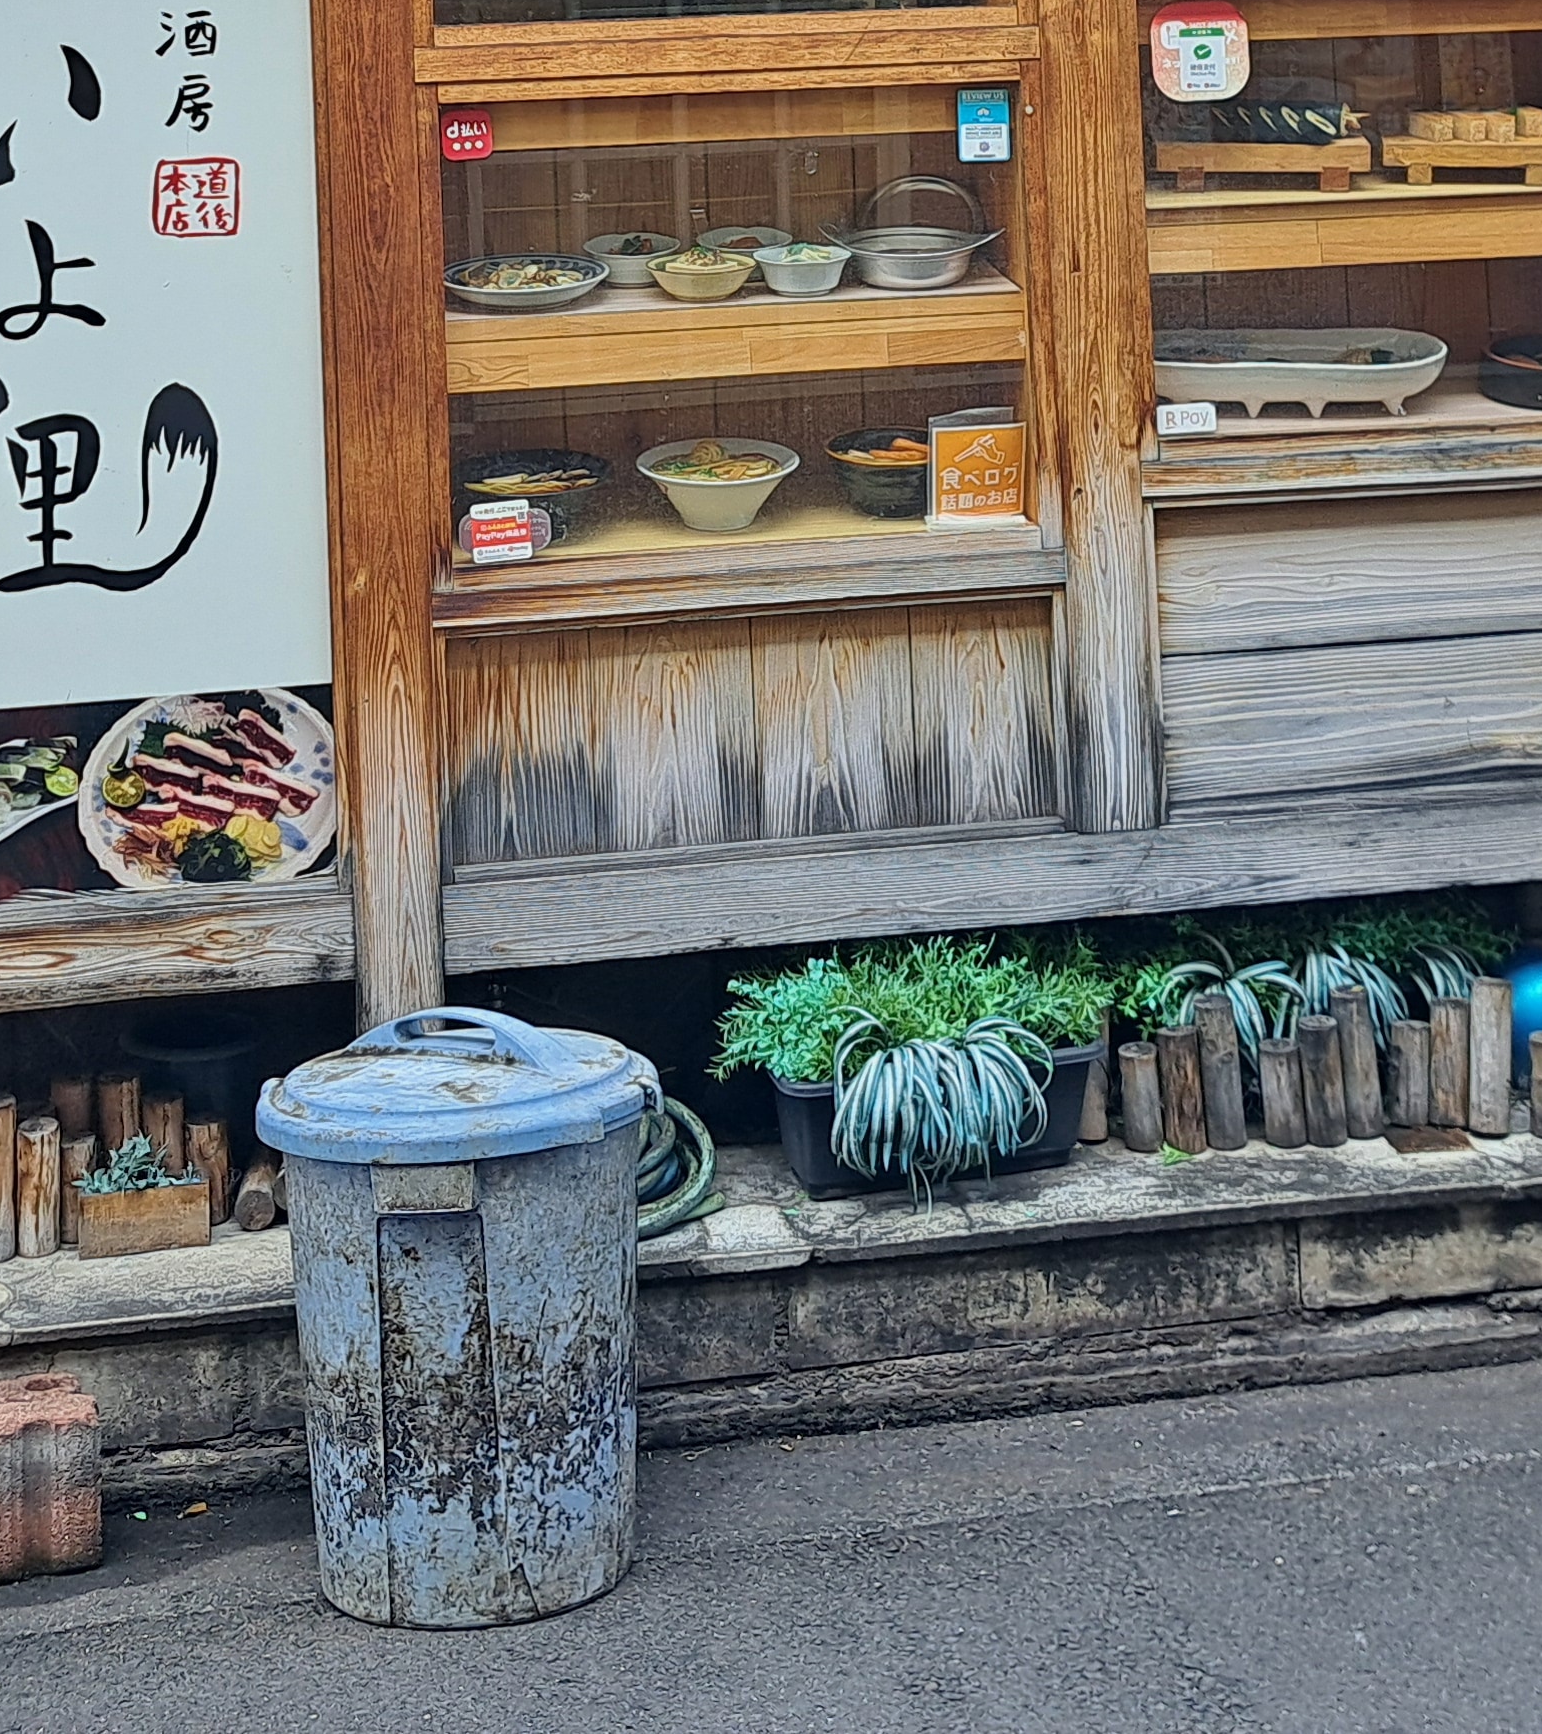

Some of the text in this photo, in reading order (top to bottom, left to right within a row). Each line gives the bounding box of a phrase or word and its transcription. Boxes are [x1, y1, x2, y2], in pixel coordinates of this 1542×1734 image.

[445, 120, 488, 140] d払い
[939, 461, 1020, 491] 食べログ
[940, 487, 1019, 511] 話題のお店
